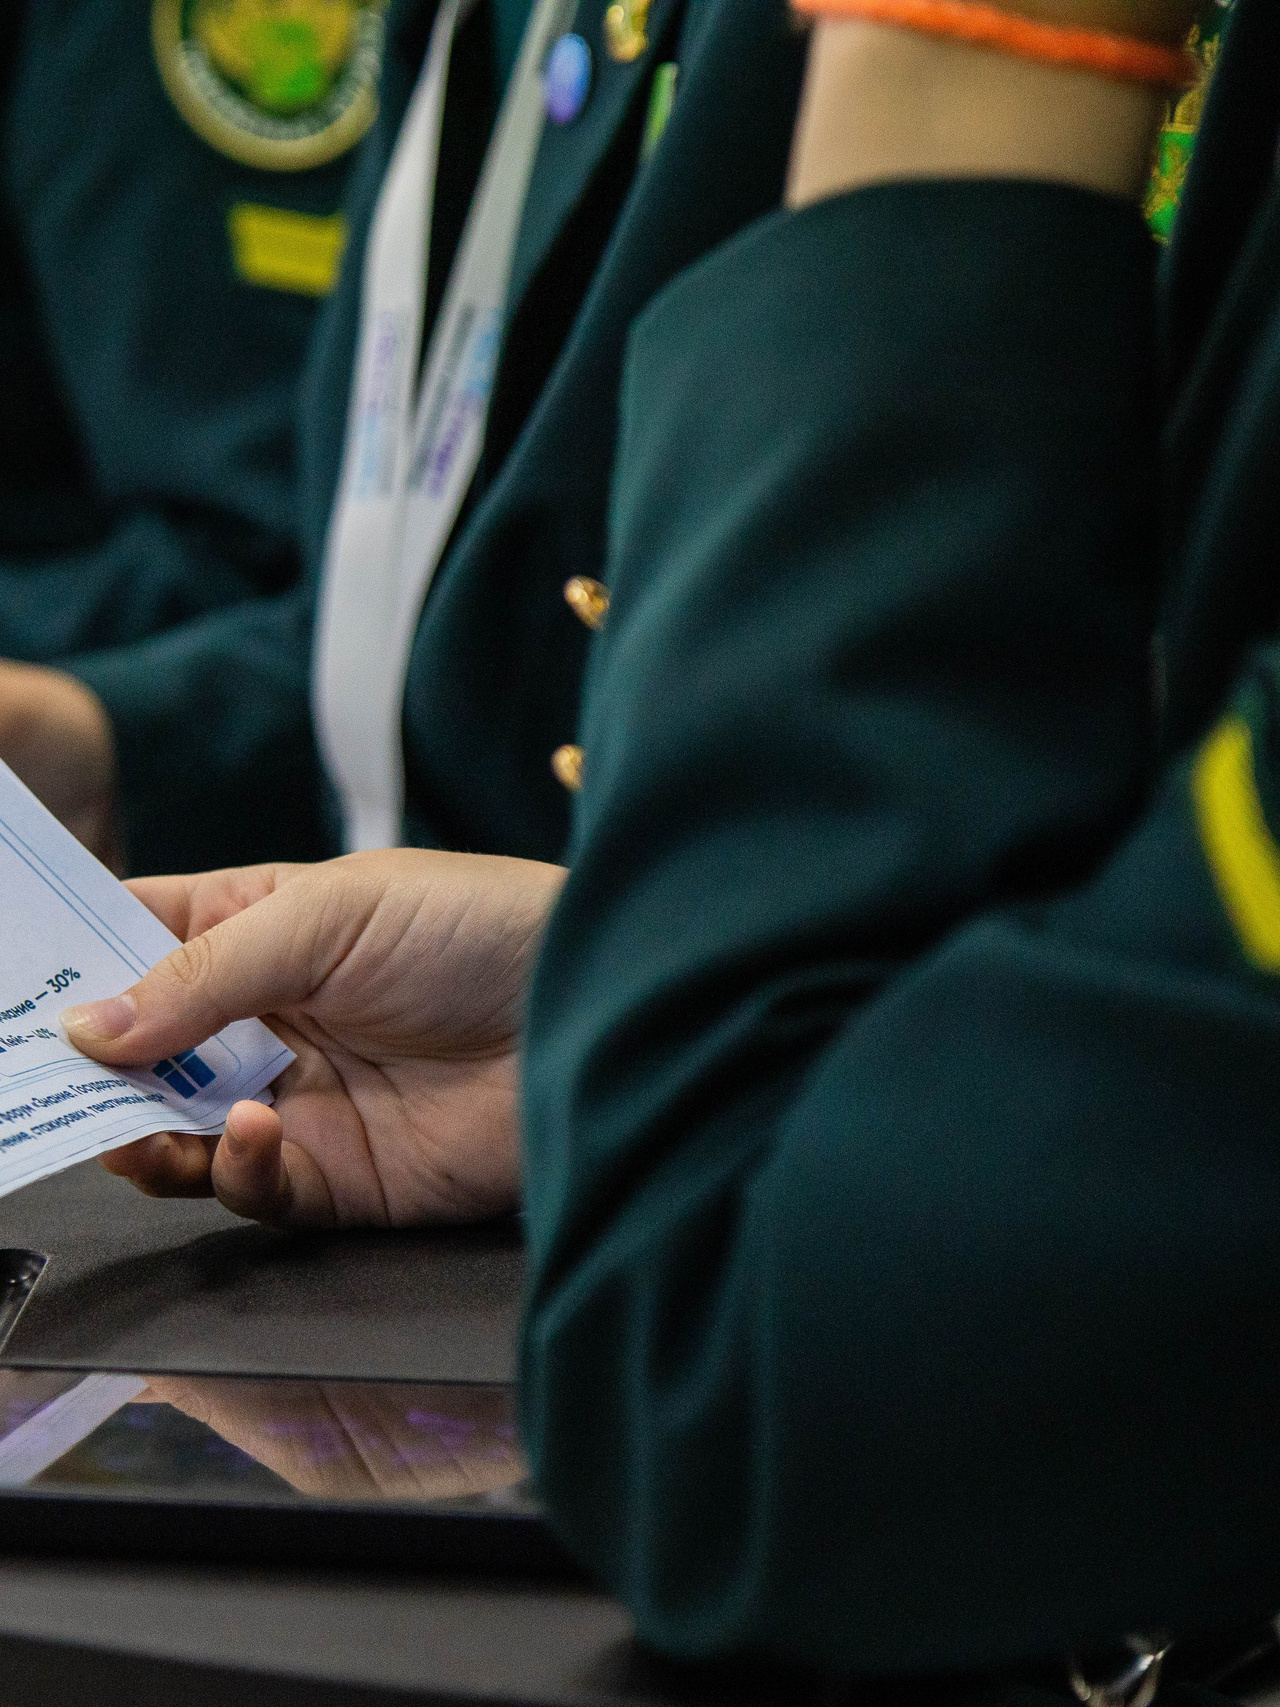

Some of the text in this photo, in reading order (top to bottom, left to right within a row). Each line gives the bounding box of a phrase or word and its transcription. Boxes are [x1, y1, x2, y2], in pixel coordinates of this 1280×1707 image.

[45, 967, 81, 993] 30%
[34, 1028, 57, 1039] 40%
[0, 1102, 34, 1126] форум
[31, 1088, 78, 1111] «Знание.
[31, 1109, 95, 1136] стажировки,
[86, 1093, 146, 1113] тематический
